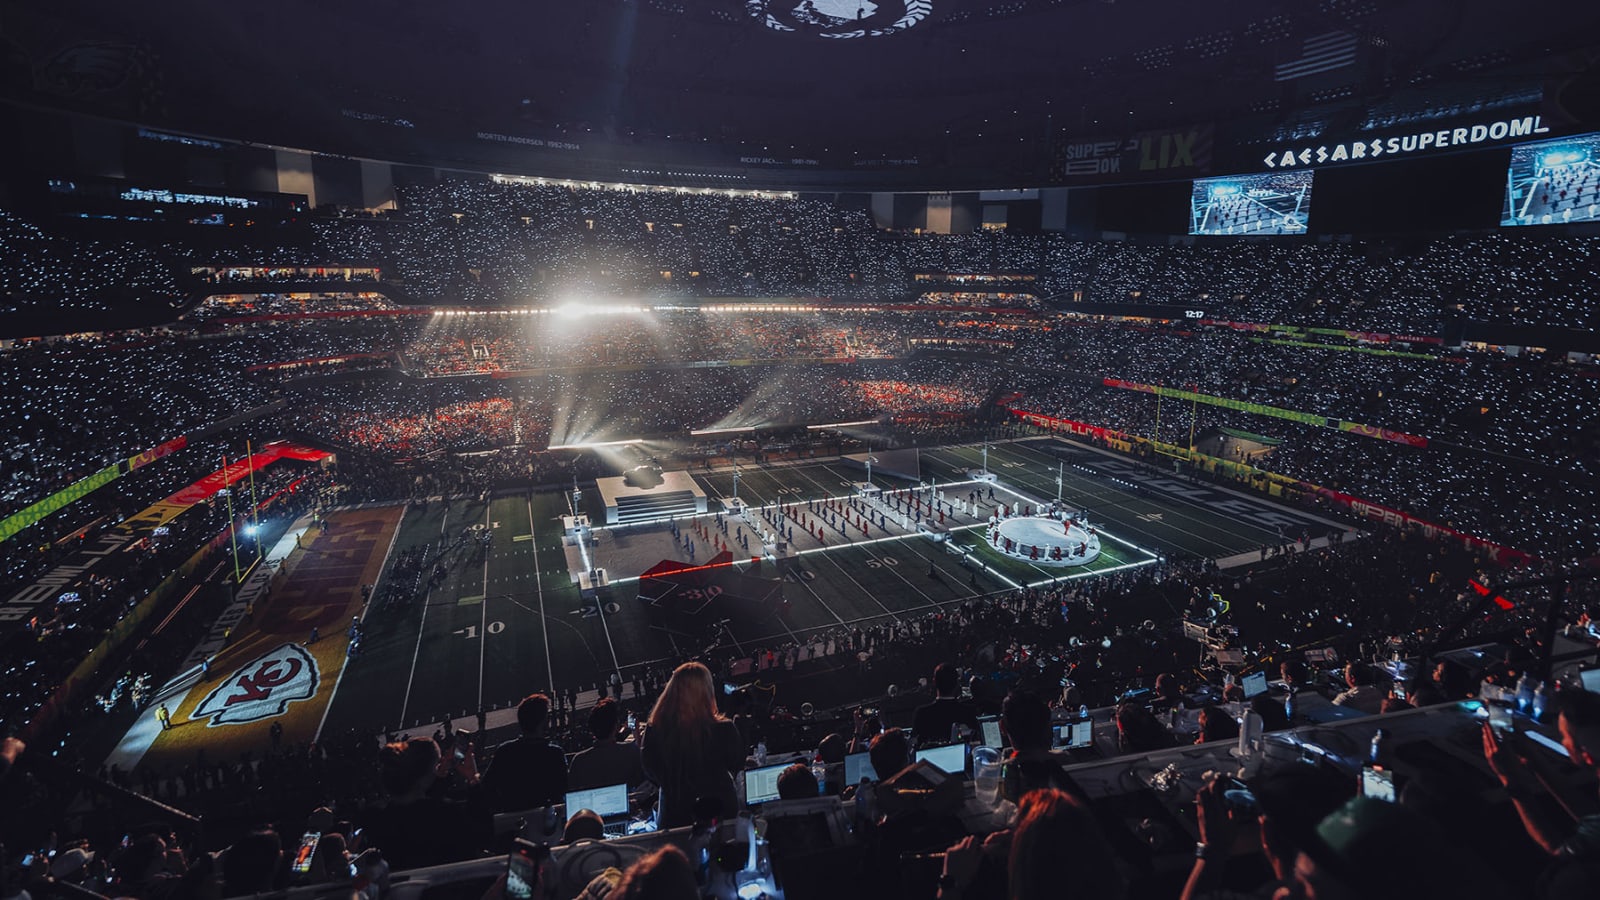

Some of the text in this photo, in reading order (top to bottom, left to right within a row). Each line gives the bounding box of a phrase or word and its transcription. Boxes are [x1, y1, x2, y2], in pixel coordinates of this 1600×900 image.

[1139, 131, 1199, 171] LIX
[864, 556, 899, 570] 50
[463, 620, 506, 640] 10
[225, 657, 303, 706] KC
